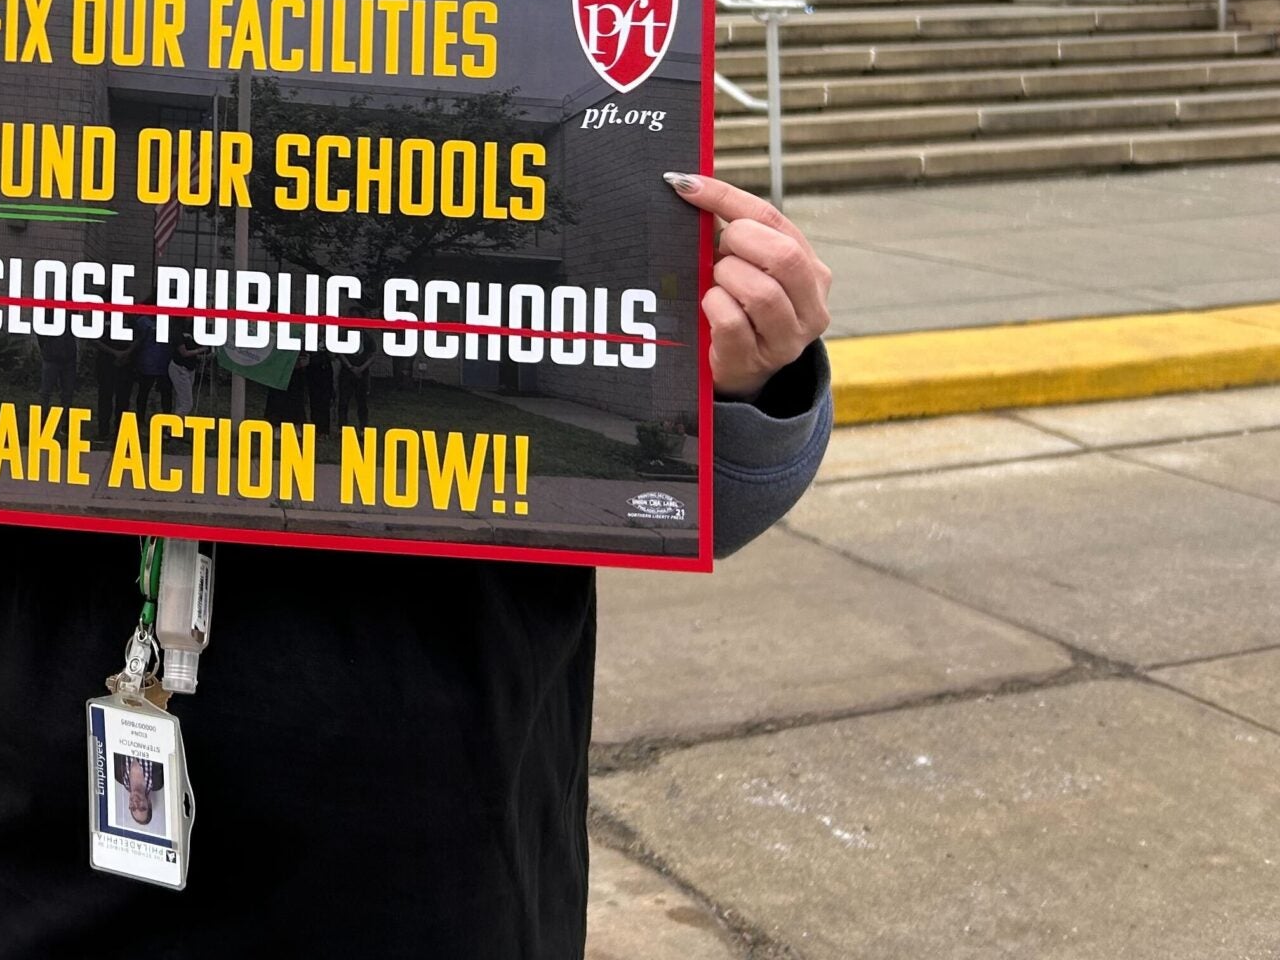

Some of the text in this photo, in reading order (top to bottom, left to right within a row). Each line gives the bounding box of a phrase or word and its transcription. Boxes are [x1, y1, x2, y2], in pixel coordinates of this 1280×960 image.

[580, 103, 667, 132] pft.org
[137, 128, 252, 208] OUR
[275, 132, 546, 221] SCHOOLS
[156, 266, 360, 354] PUBLIC
[383, 277, 656, 368] SCHOOLS
[107, 411, 316, 502] ACTION
[340, 426, 530, 515] NOW!!
[96, 740, 106, 796] Employee
[97, 832, 164, 855] PHILADELPHIA
